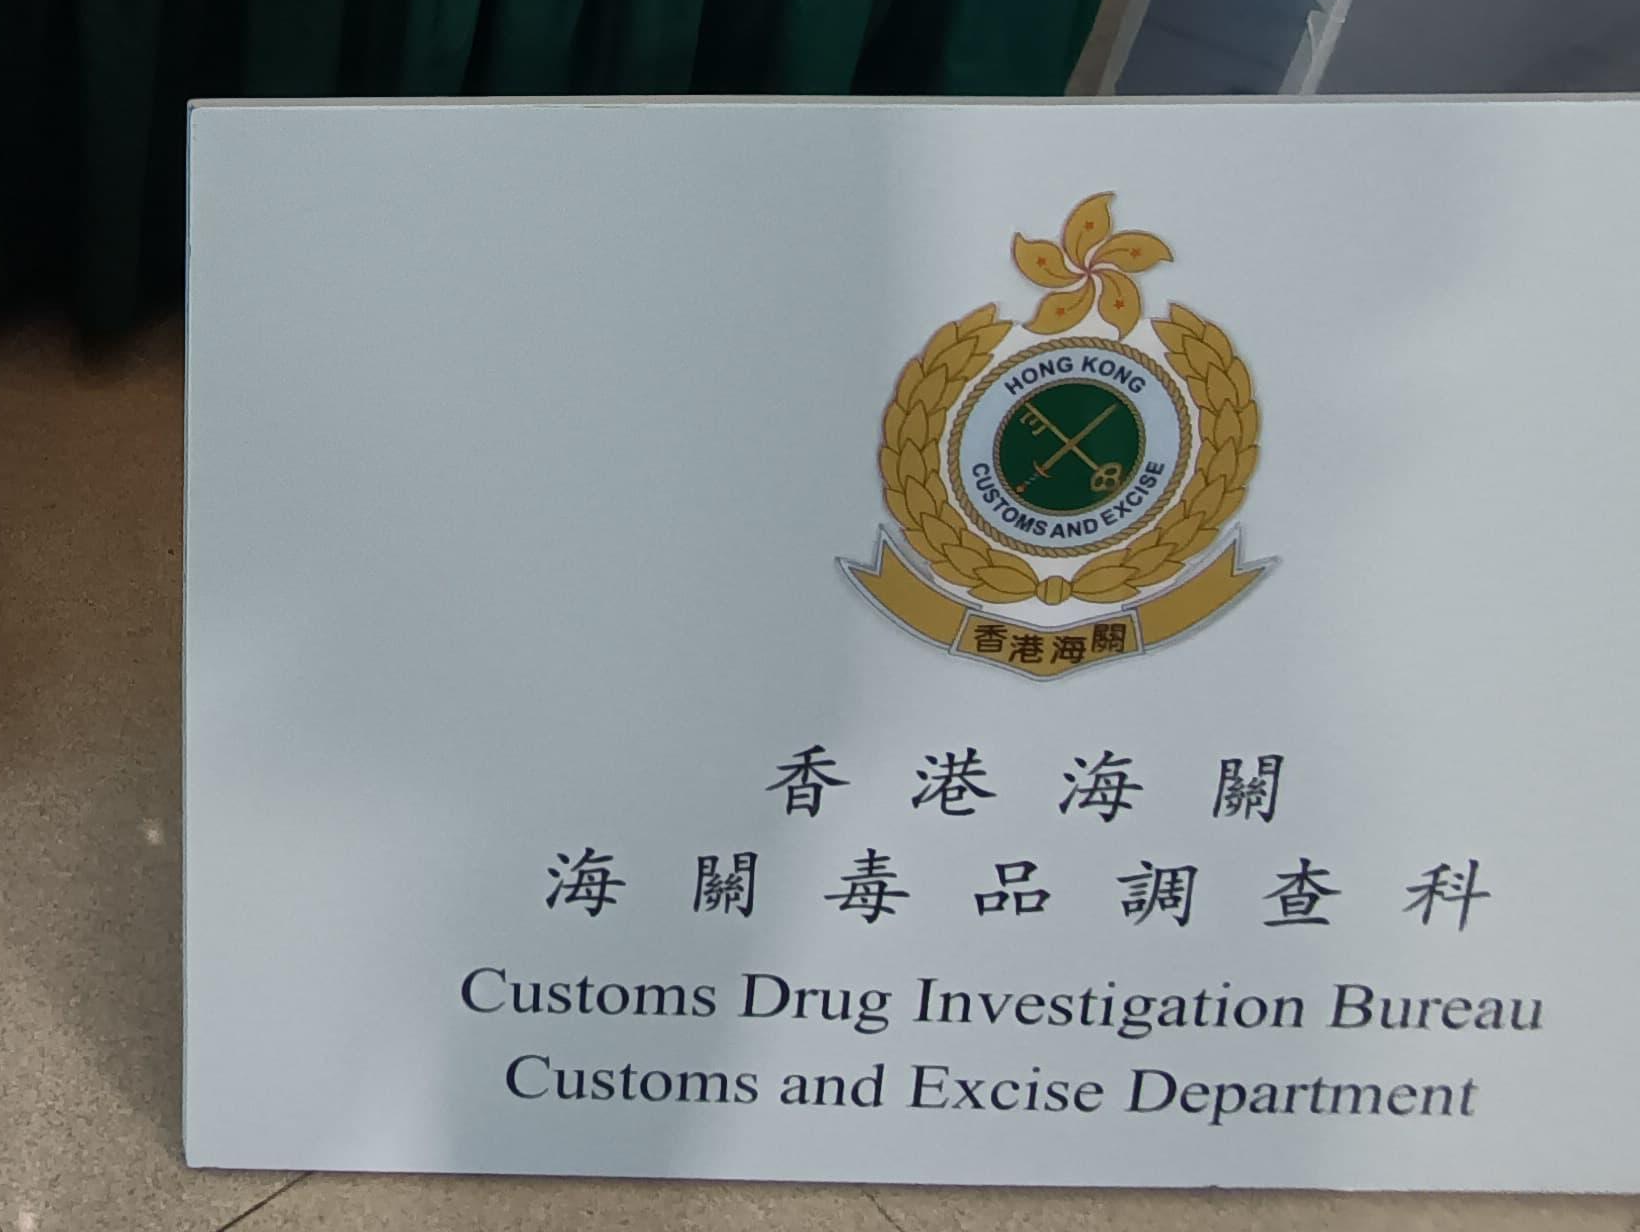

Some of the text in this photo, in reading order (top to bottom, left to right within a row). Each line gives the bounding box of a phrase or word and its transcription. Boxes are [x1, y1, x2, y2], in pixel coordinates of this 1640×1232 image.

[1004, 355, 1147, 396] HONG KONG
[971, 460, 1165, 539] CUSTOMS AND EXCISE
[974, 623, 1127, 664] 香港海關
[765, 744, 1285, 823] 香港海關
[544, 846, 1492, 932] 海關毒品調查科
[460, 967, 1544, 1040] Customs Drug Investigation Bureau
[505, 1054, 1480, 1127] Customs and Excise Department
